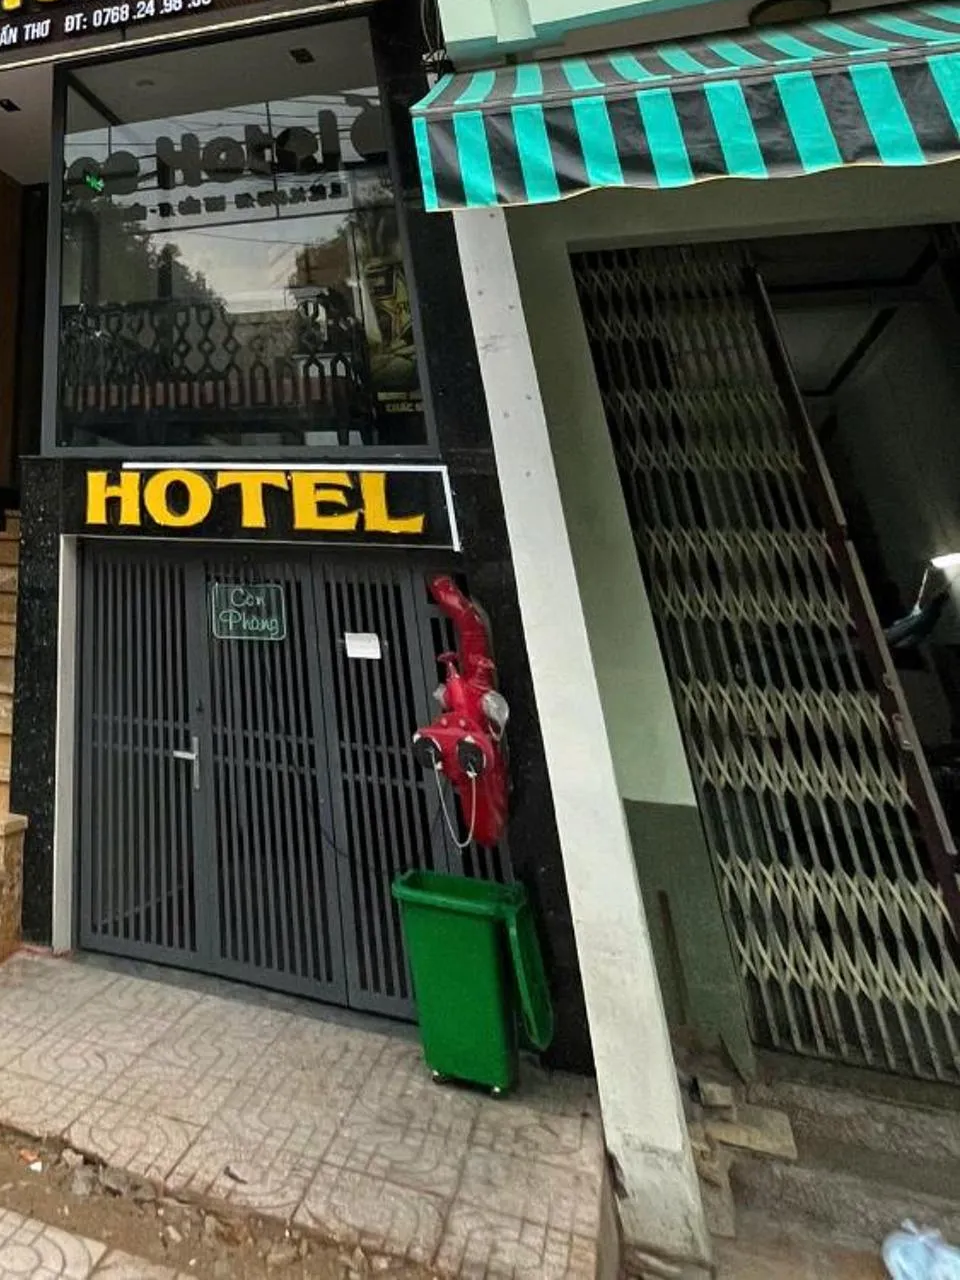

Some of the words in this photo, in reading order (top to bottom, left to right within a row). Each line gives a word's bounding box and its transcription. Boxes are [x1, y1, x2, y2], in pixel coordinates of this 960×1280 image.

[23, 19, 51, 41] THƠ
[64, 13, 88, 33] ĐT:
[92, 4, 130, 27] 0768
[86, 468, 426, 534] HOTEL
